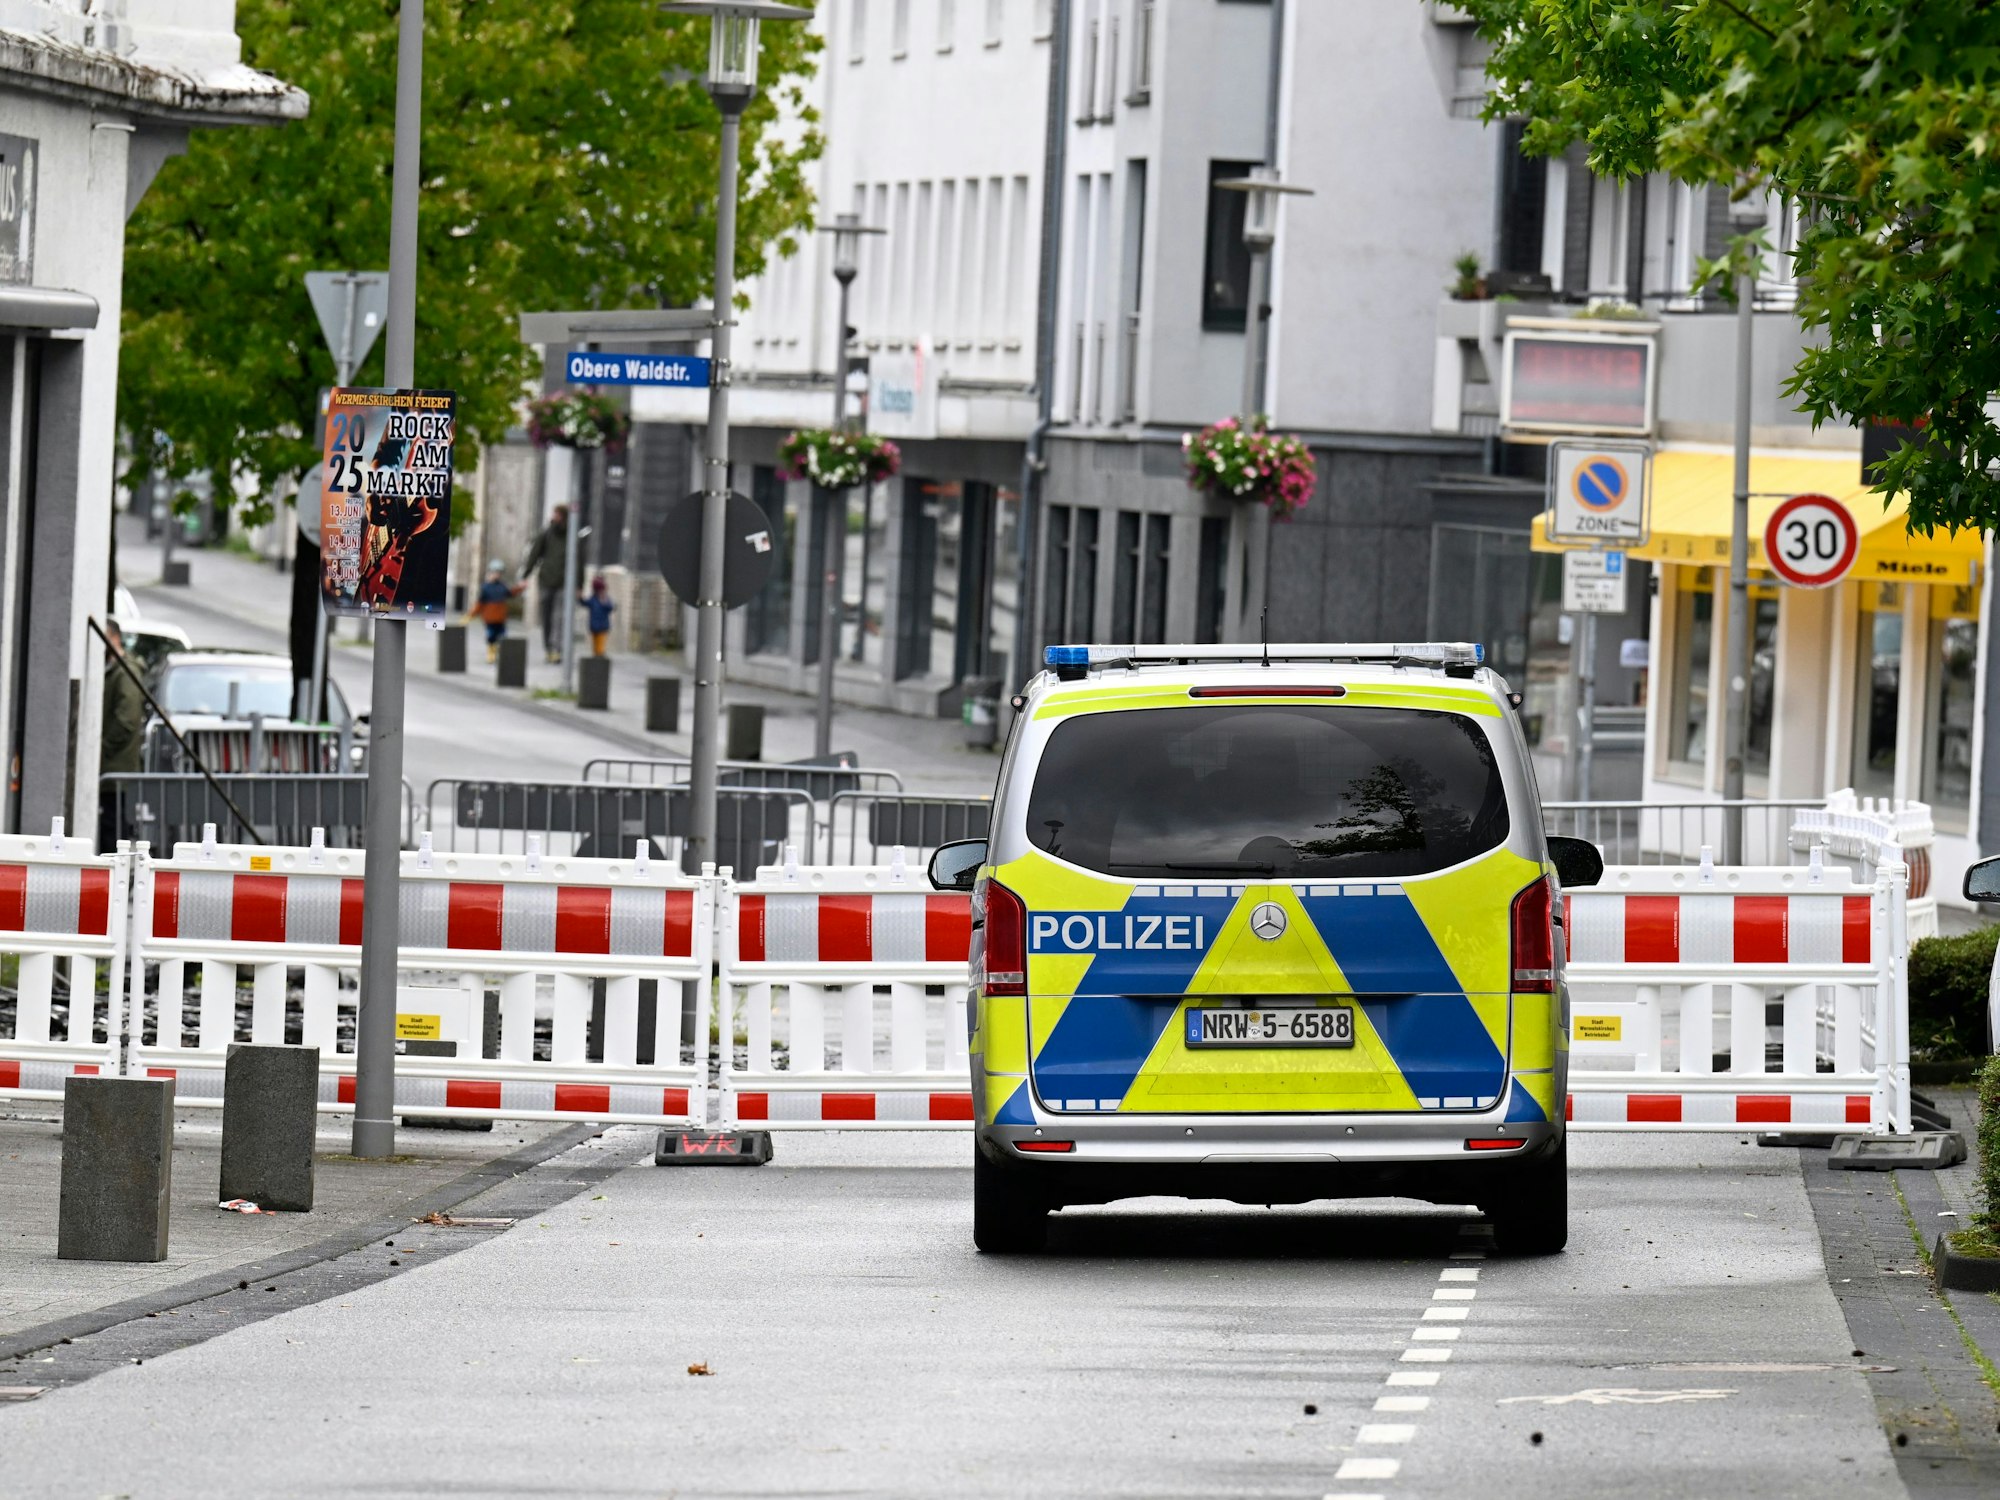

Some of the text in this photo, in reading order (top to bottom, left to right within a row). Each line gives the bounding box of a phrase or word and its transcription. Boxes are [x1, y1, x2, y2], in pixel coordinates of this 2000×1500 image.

[570, 357, 691, 381] Obere Waldstr.
[335, 393, 451, 409] WERMELSKIRCHEN FEIERT
[331, 412, 366, 453] 20
[389, 415, 449, 441] ROCK
[411, 444, 448, 469] AM
[328, 453, 363, 494] 25
[366, 471, 447, 497] MARKT
[1576, 515, 1620, 532] ZONE
[1785, 520, 1837, 560] 30
[1877, 561, 1948, 575] Miele
[1033, 915, 1203, 950] POLIZEI
[1203, 1014, 1248, 1038] NRW
[1263, 1014, 1349, 1038] 5-6588
